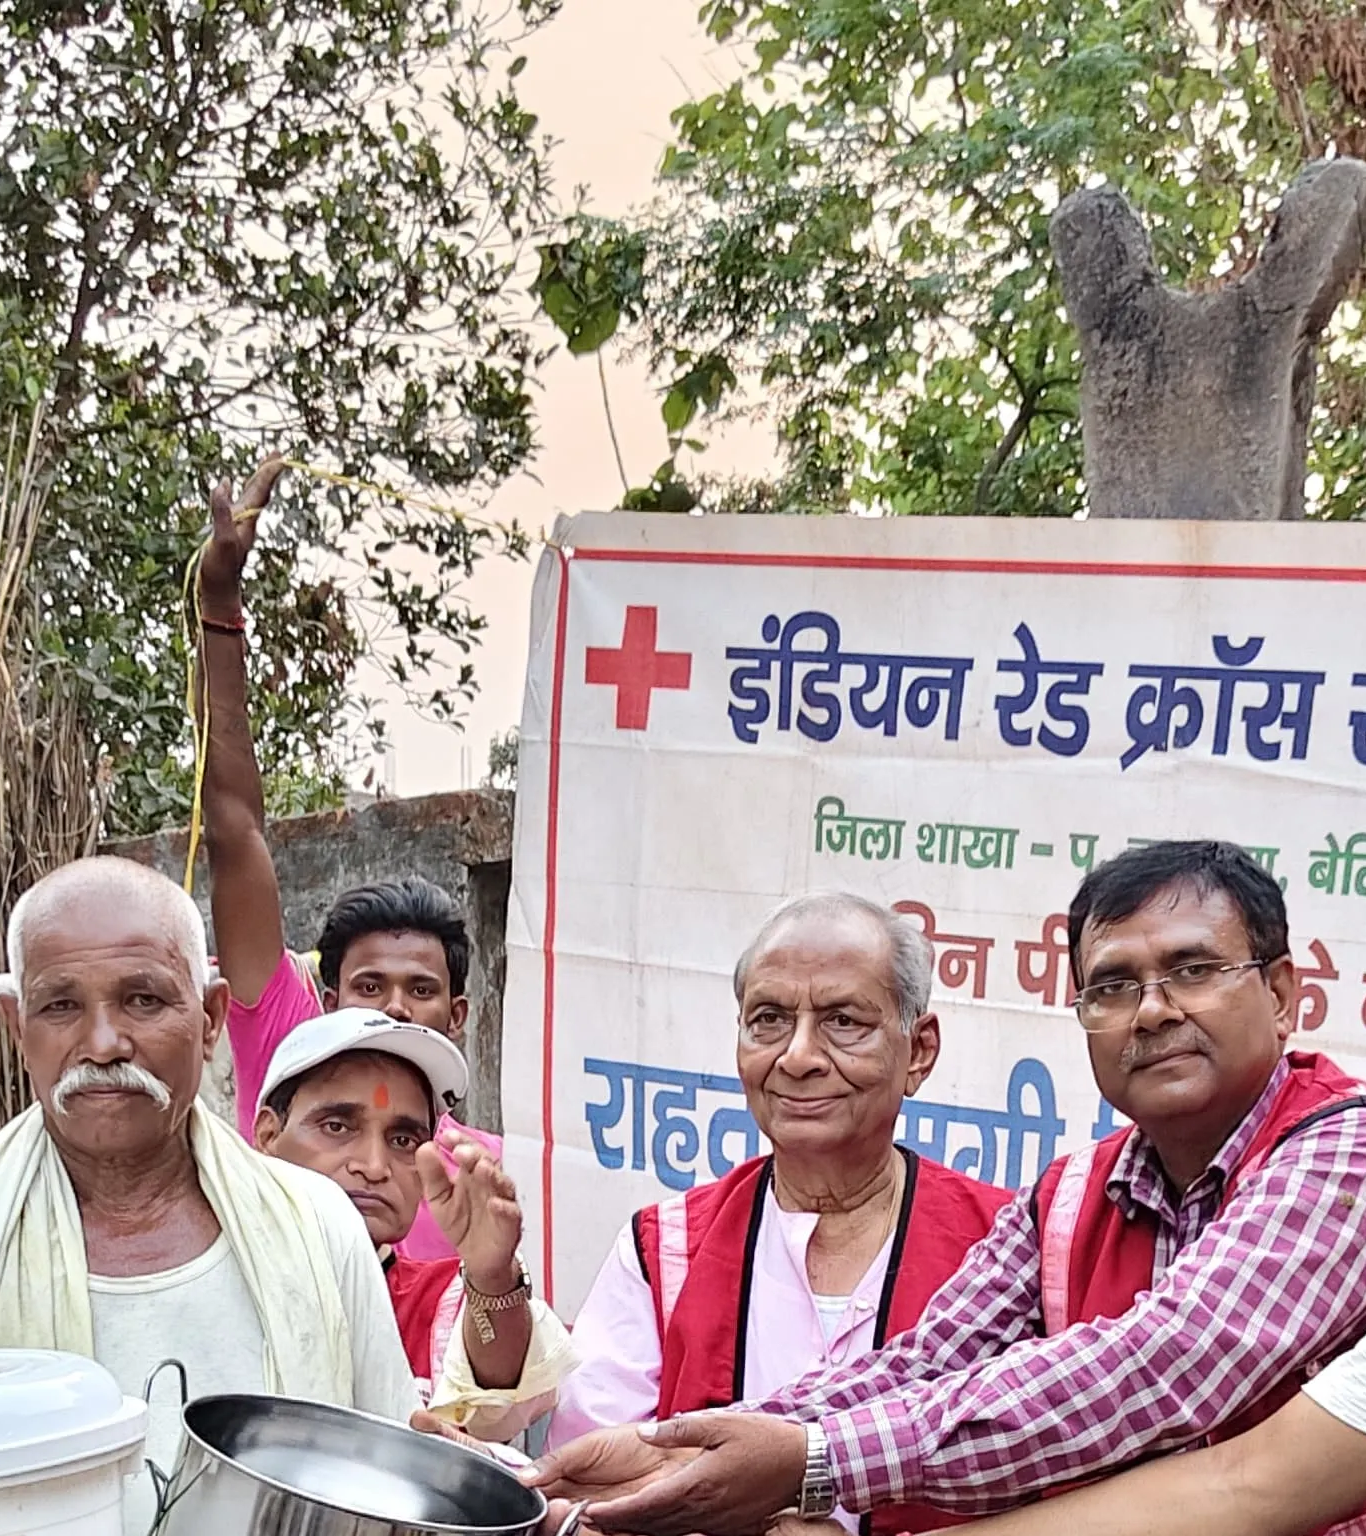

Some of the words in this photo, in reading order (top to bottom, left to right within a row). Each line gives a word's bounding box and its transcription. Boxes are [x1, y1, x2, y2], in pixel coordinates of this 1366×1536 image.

[725, 611, 974, 743] इंडियन
[994, 622, 1104, 757] रेड
[1119, 635, 1326, 771] क्रॉस
[814, 795, 906, 861] जिला
[916, 823, 1019, 870] शाखा
